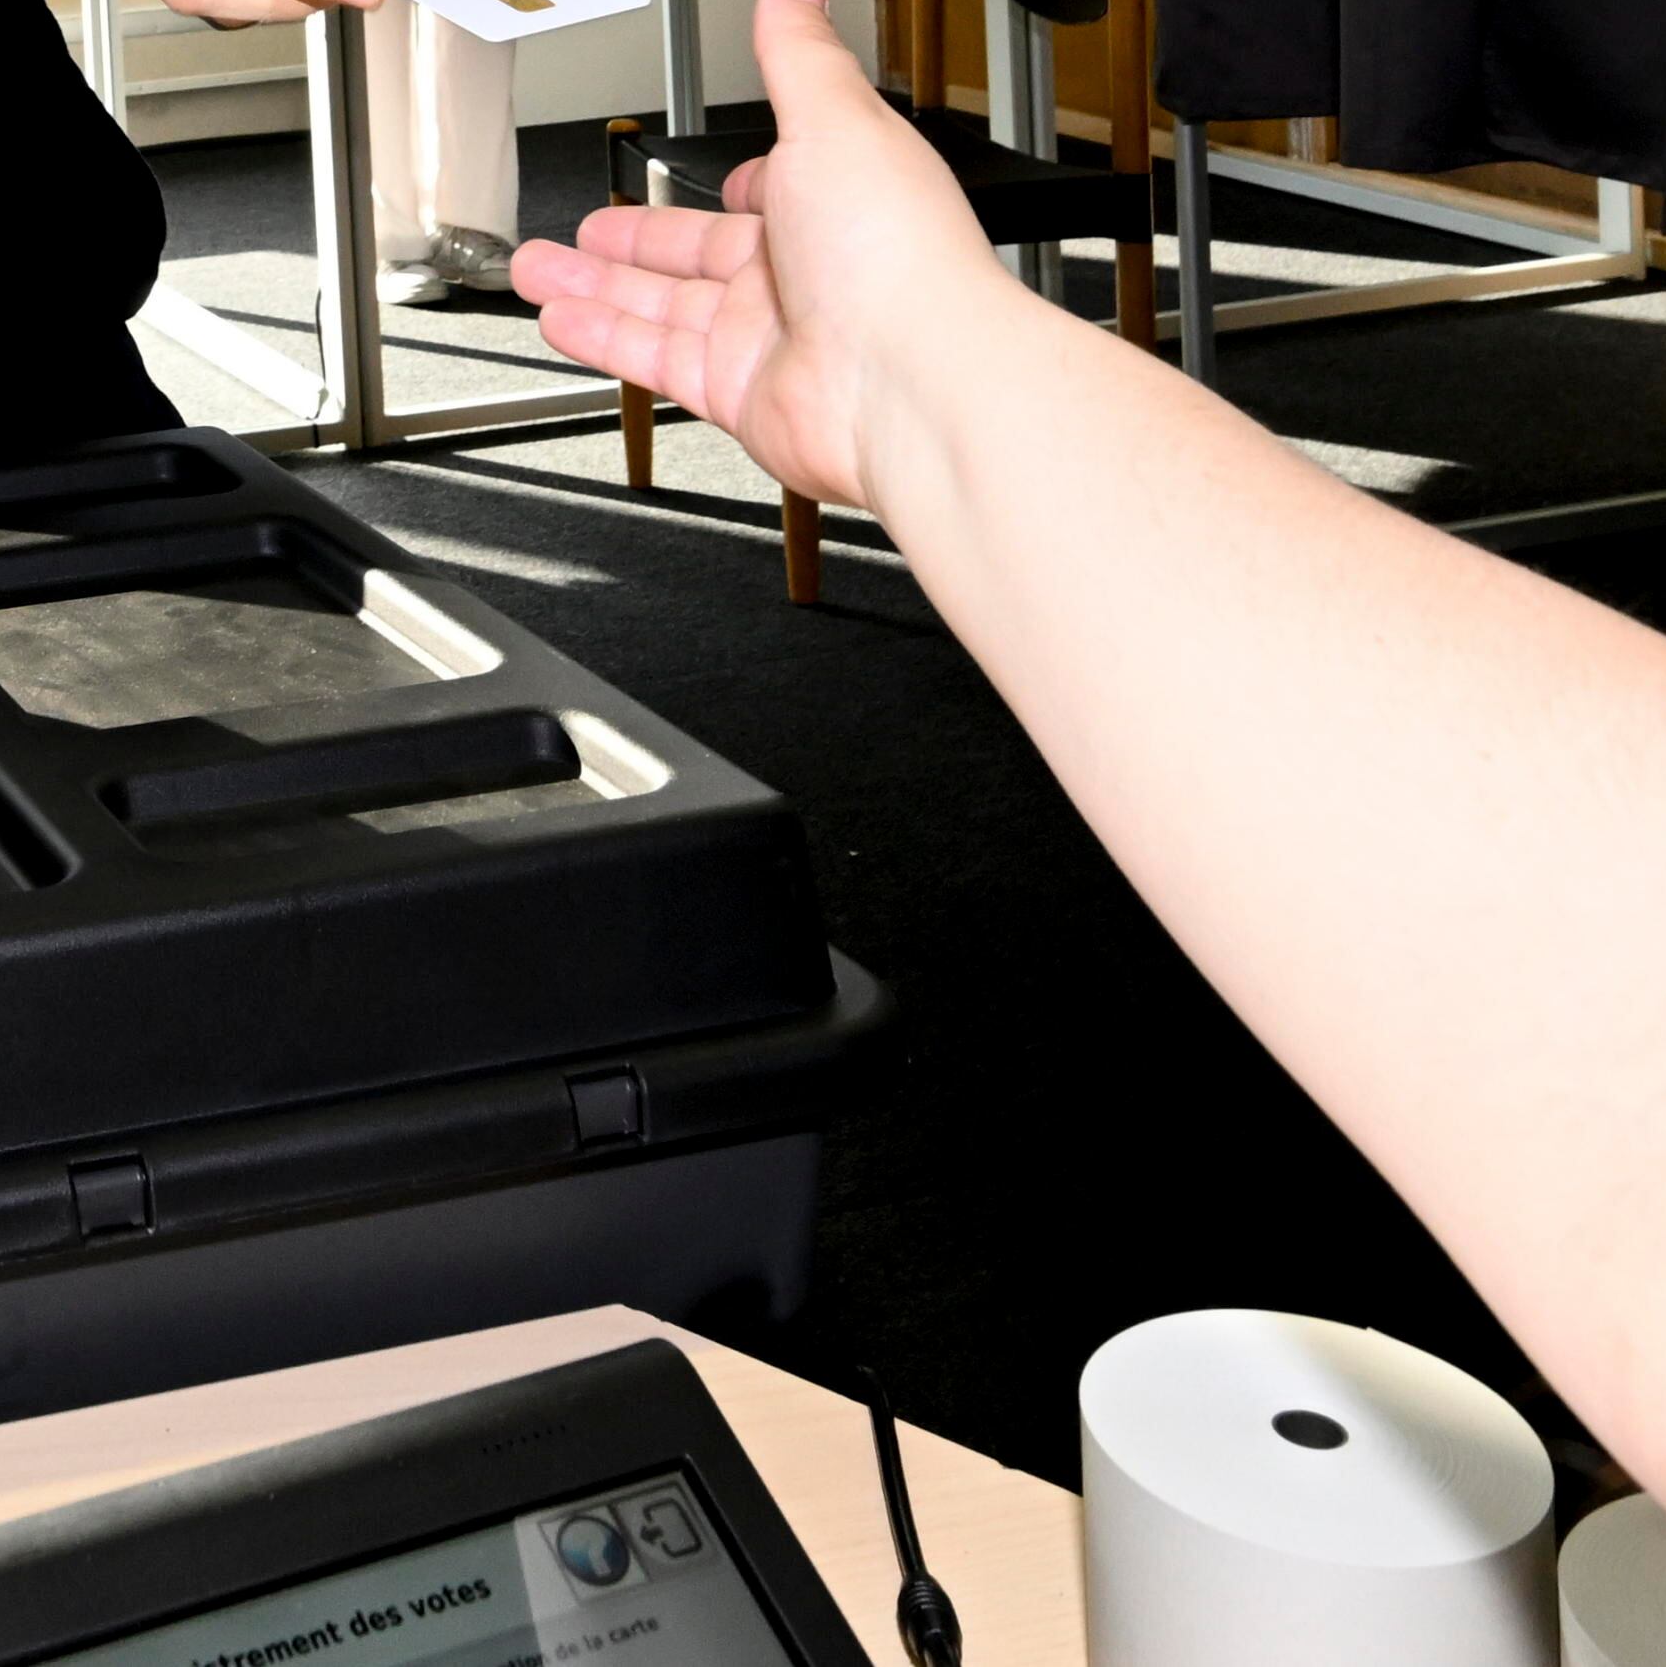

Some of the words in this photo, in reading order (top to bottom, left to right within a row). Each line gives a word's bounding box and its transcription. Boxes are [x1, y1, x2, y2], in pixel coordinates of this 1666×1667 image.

[349, 1605, 403, 1637] des
[409, 1578, 492, 1619] votes
[608, 1617, 661, 1645] carte
